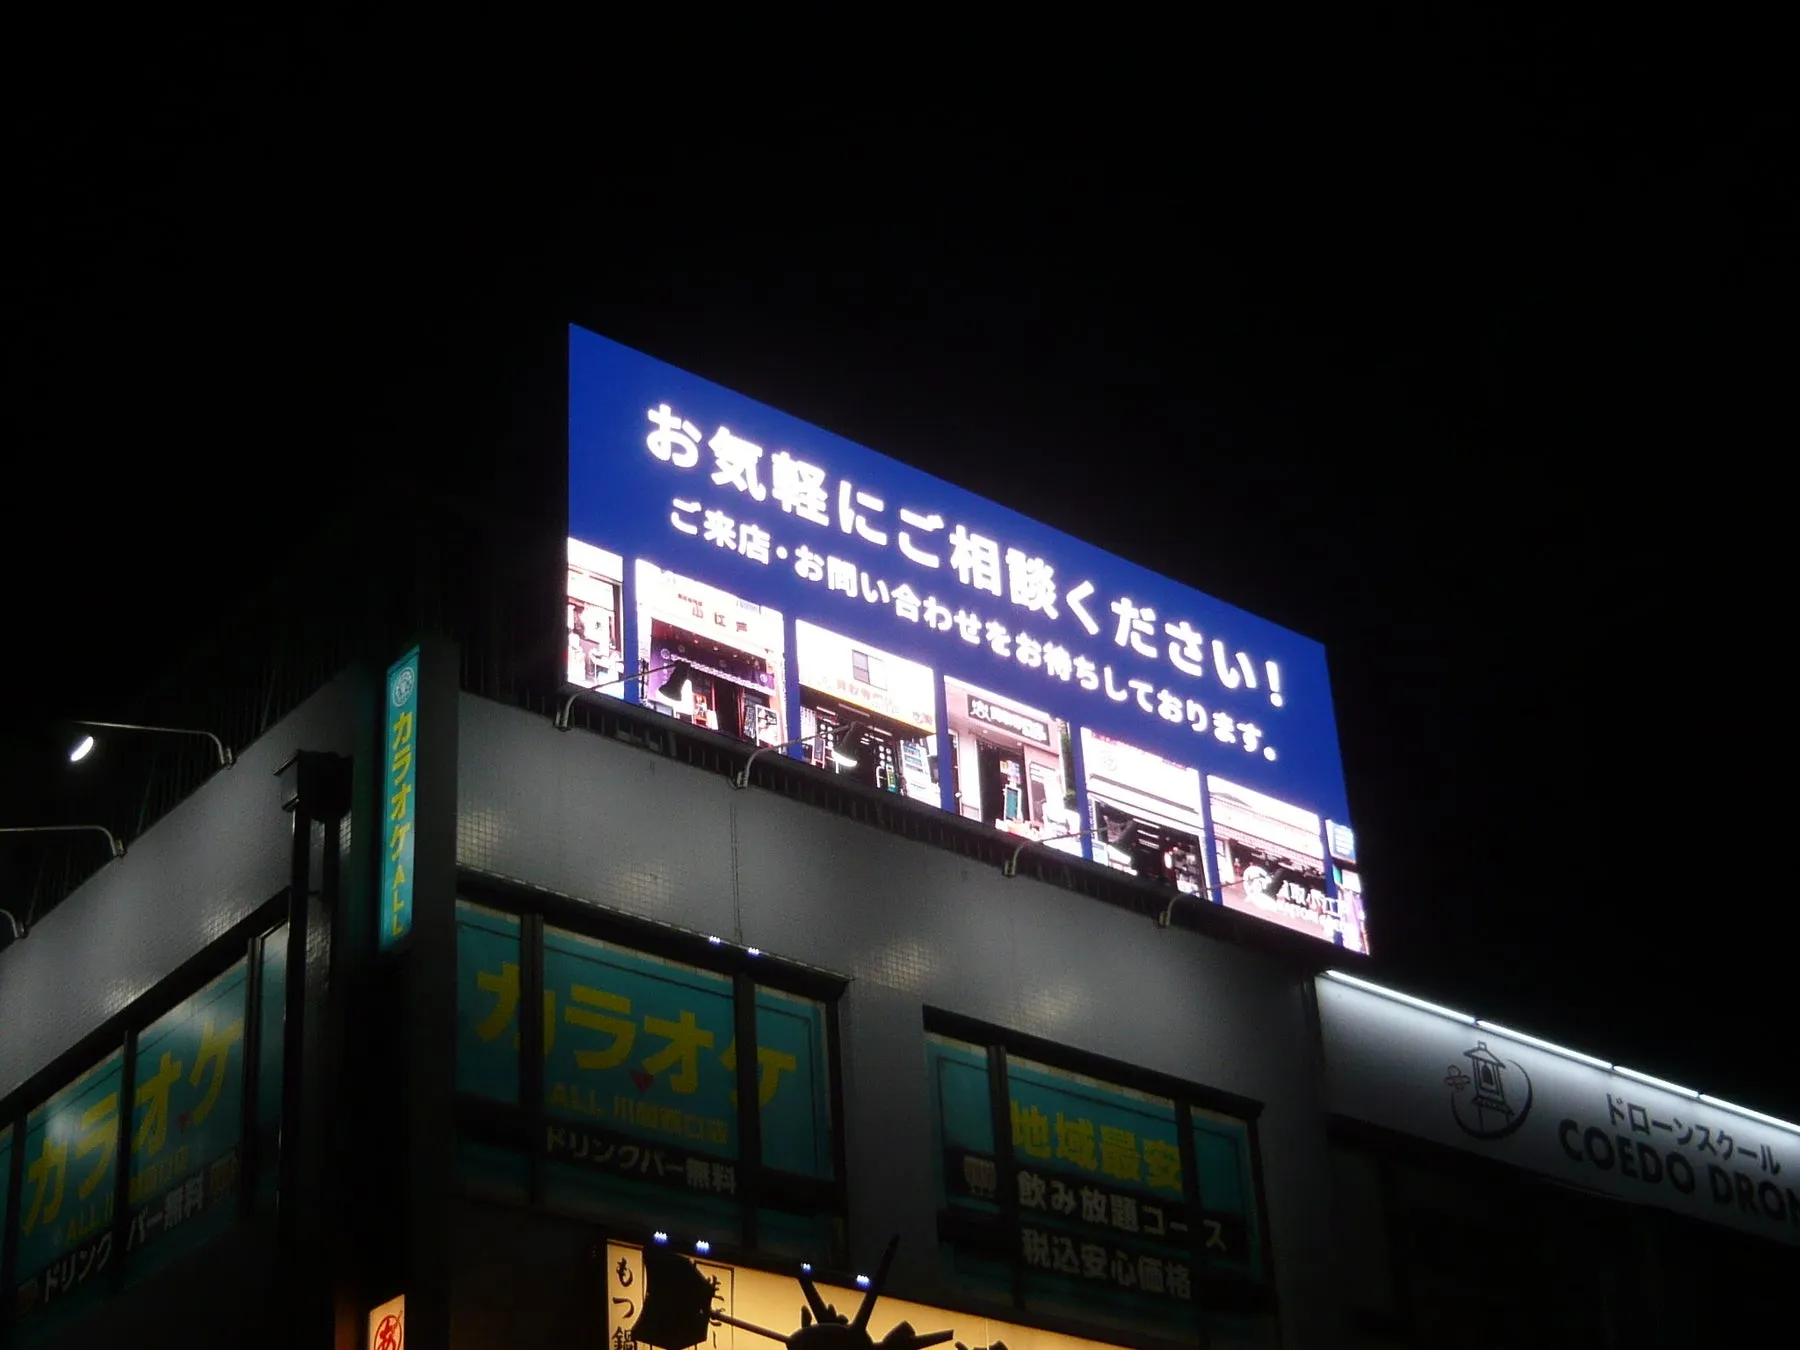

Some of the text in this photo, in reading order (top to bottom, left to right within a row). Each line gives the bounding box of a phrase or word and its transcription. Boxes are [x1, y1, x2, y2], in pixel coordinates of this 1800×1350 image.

[670, 496, 1278, 763] ご来店・お問い合わせをお待ちしております。
[477, 962, 795, 1108] カラオケ
[22, 1018, 242, 1236] カラオケ
[546, 1124, 738, 1195] ドリンクバー無料
[1011, 1100, 1181, 1191] 地域最安
[1559, 1118, 1695, 1194] COEDO
[1606, 1093, 1781, 1175] ドローンスクール
[1017, 1168, 1227, 1252] 飲み放題コース
[1022, 1228, 1192, 1298] 税込安心価格
